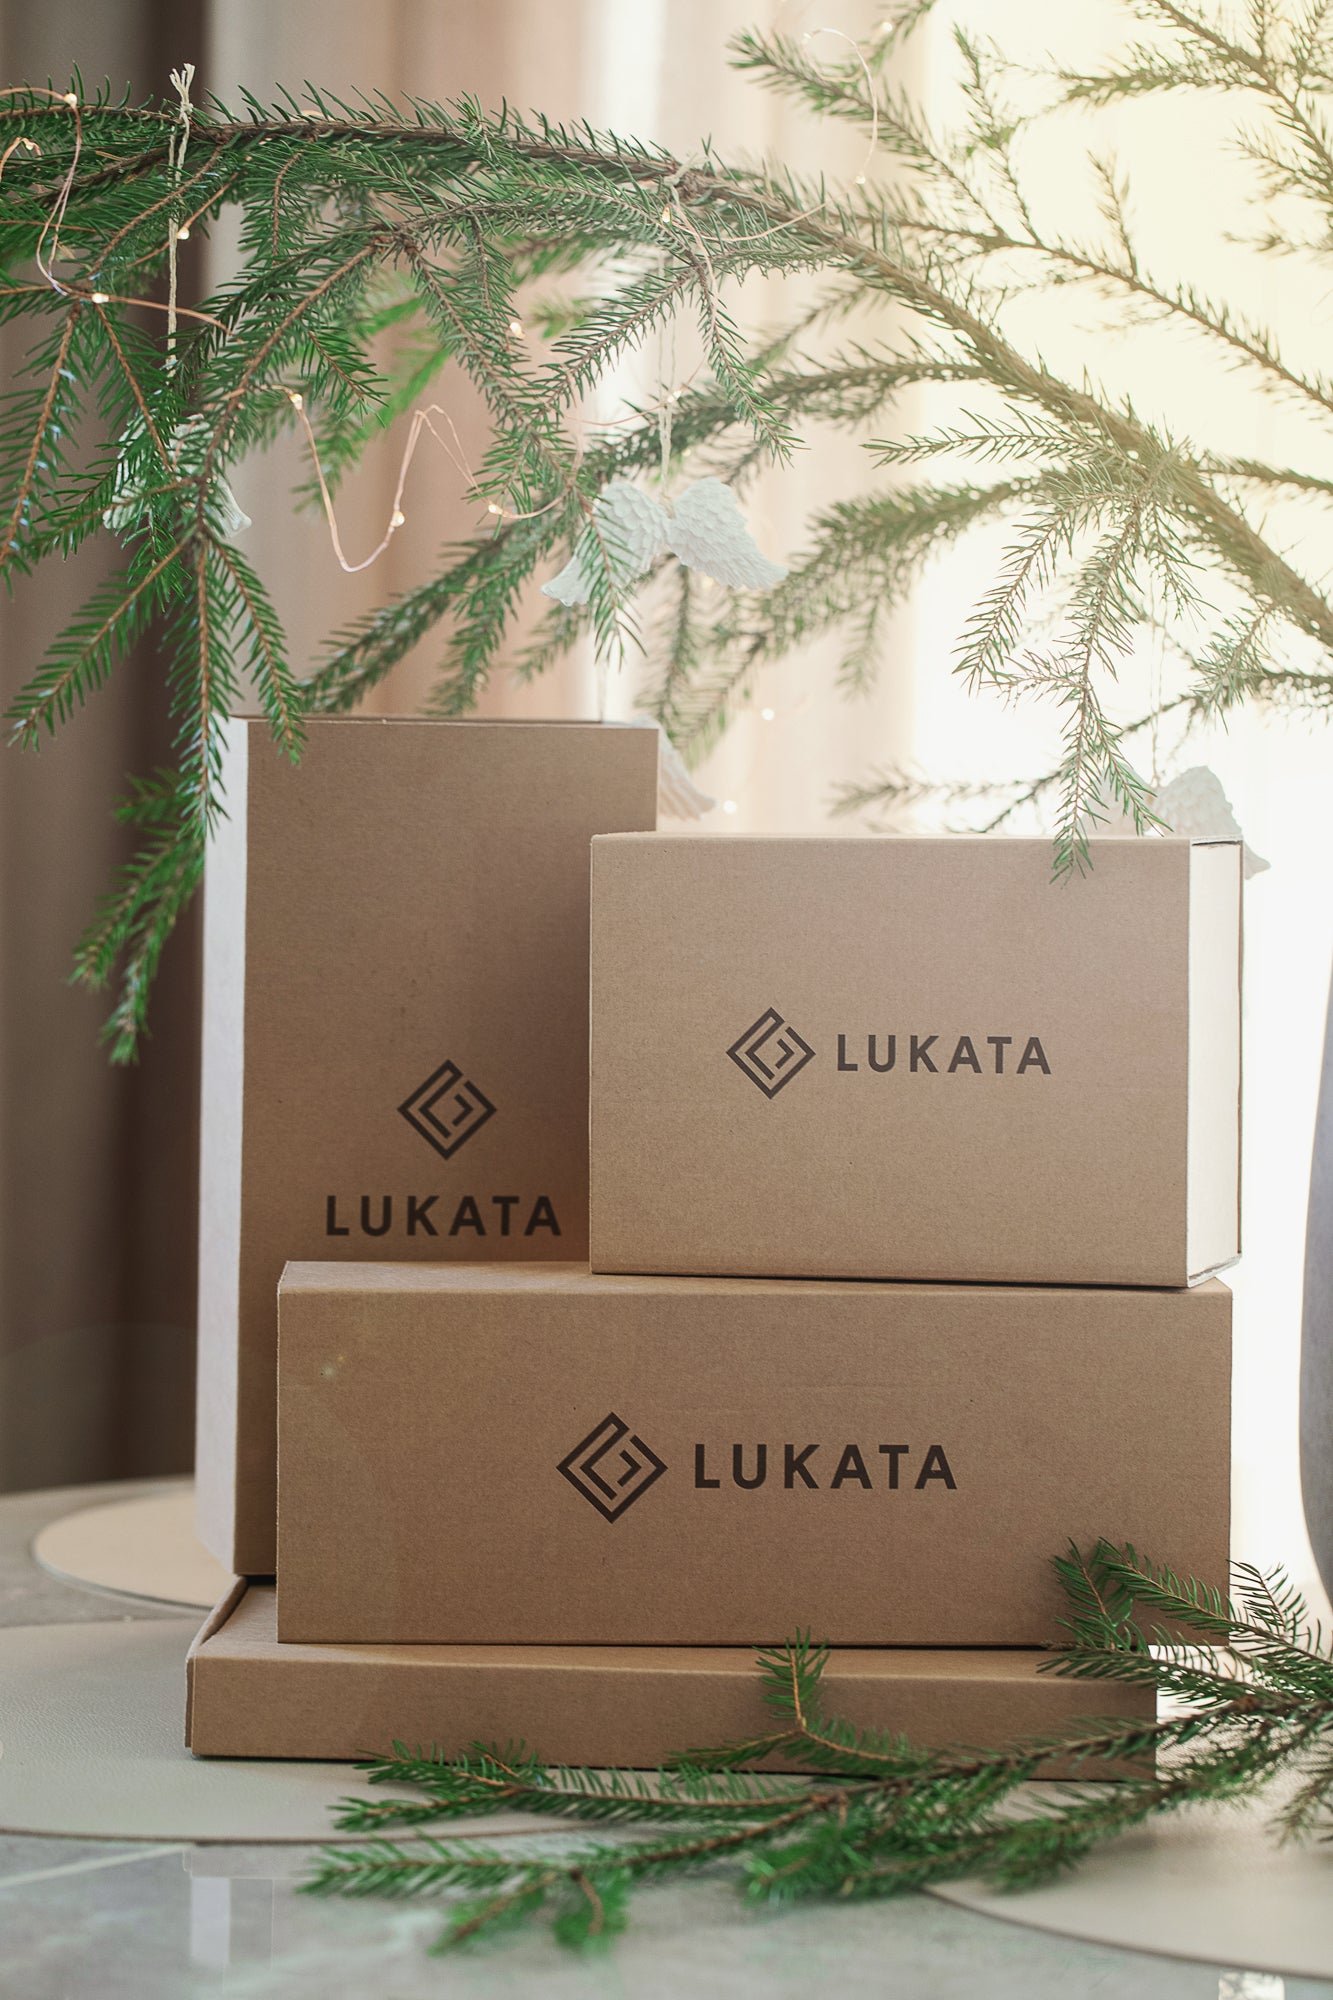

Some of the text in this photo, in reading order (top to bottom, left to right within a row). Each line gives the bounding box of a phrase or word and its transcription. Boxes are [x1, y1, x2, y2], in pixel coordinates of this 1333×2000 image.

[837, 1034, 1052, 1075] LUKATA
[326, 1194, 562, 1238] LUKATA
[694, 1443, 958, 1490] LUKATA
